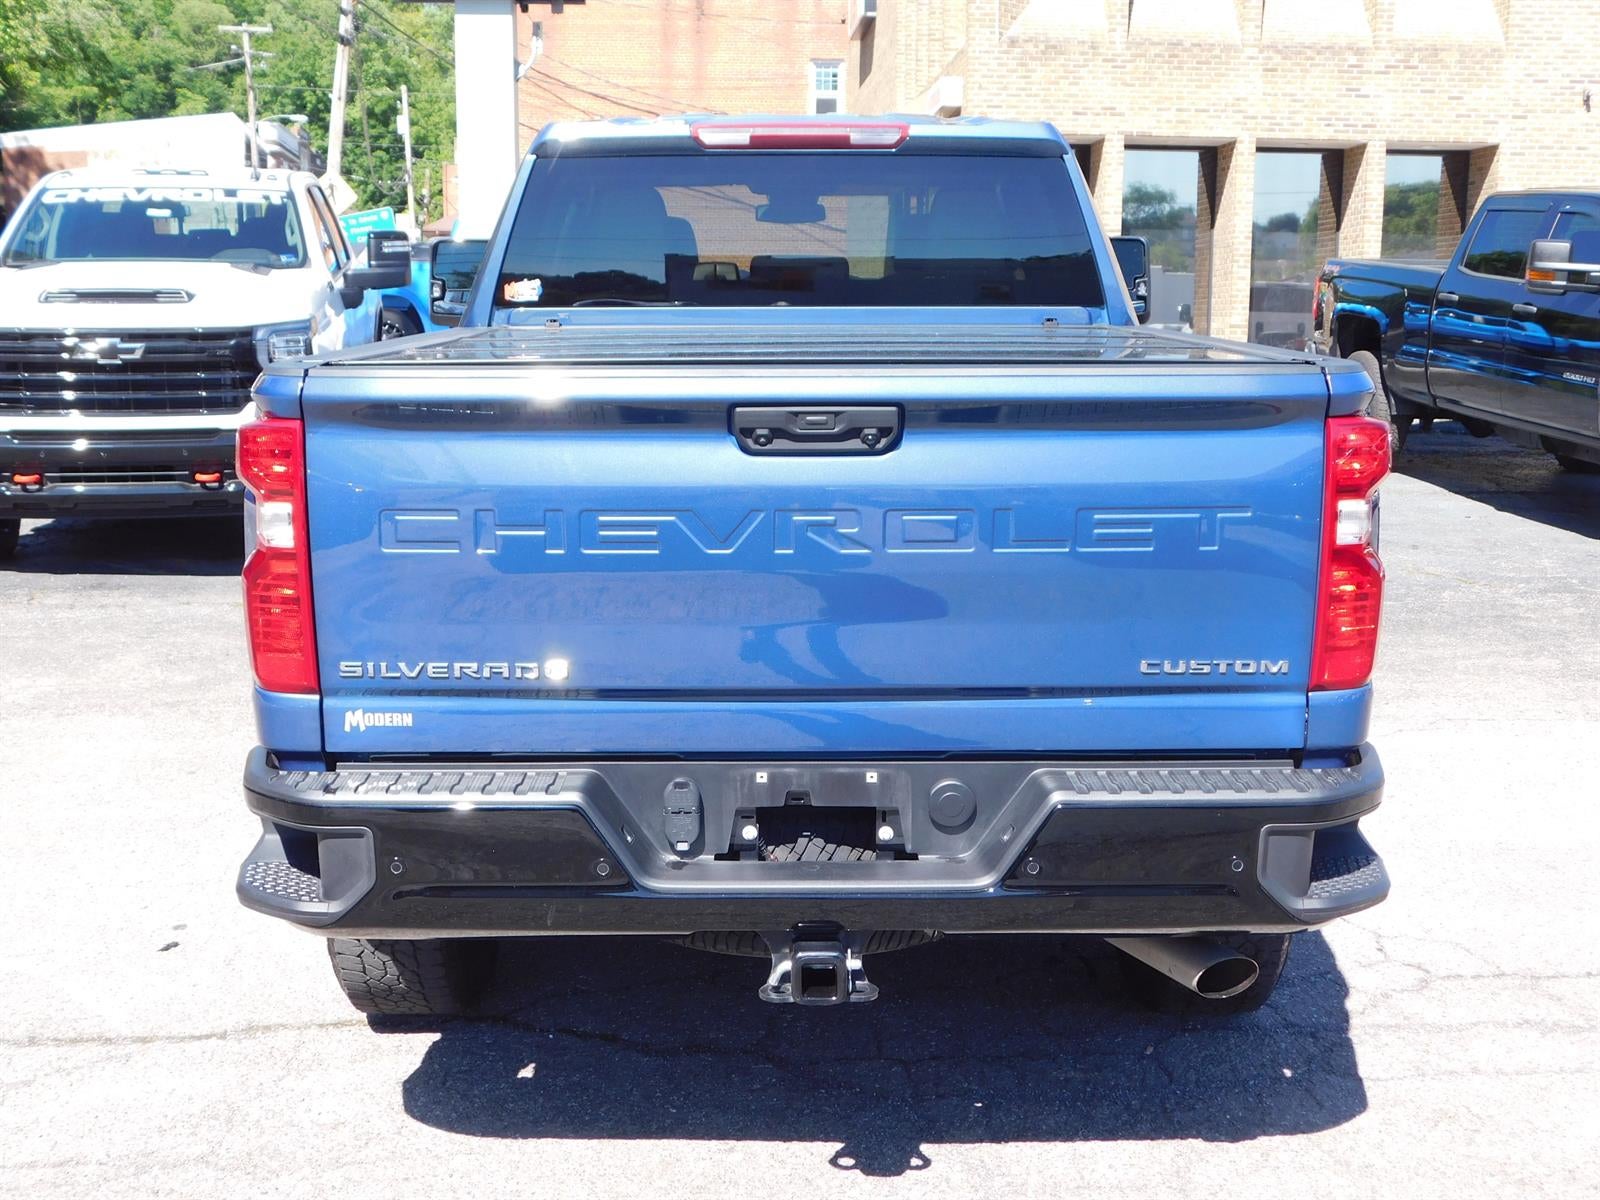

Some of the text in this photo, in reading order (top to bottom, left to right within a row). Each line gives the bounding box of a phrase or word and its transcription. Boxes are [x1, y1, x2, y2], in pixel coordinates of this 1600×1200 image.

[42, 189, 287, 204] CHEVROLET
[378, 508, 1253, 556] CHEVROLET
[1139, 659, 1290, 675] CUSTOM
